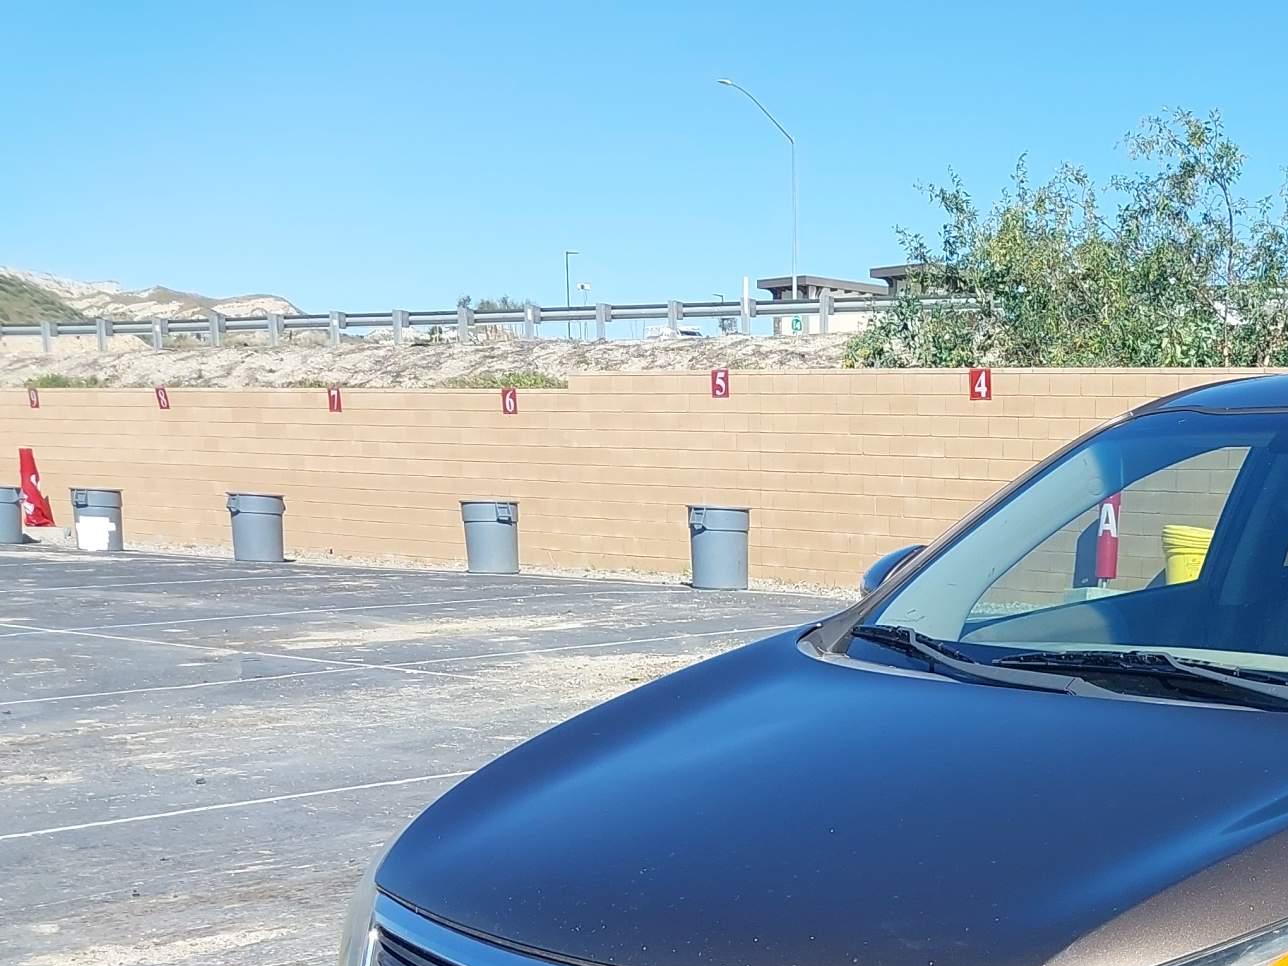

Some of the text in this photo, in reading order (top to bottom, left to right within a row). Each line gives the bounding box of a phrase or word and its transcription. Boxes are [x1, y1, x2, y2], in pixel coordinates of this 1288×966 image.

[715, 372, 726, 395] 5
[974, 370, 988, 397] 4
[30, 390, 37, 407] 9
[158, 389, 168, 408] 8
[330, 389, 338, 410] 7
[505, 390, 515, 412] 6
[1098, 503, 1118, 537] A
